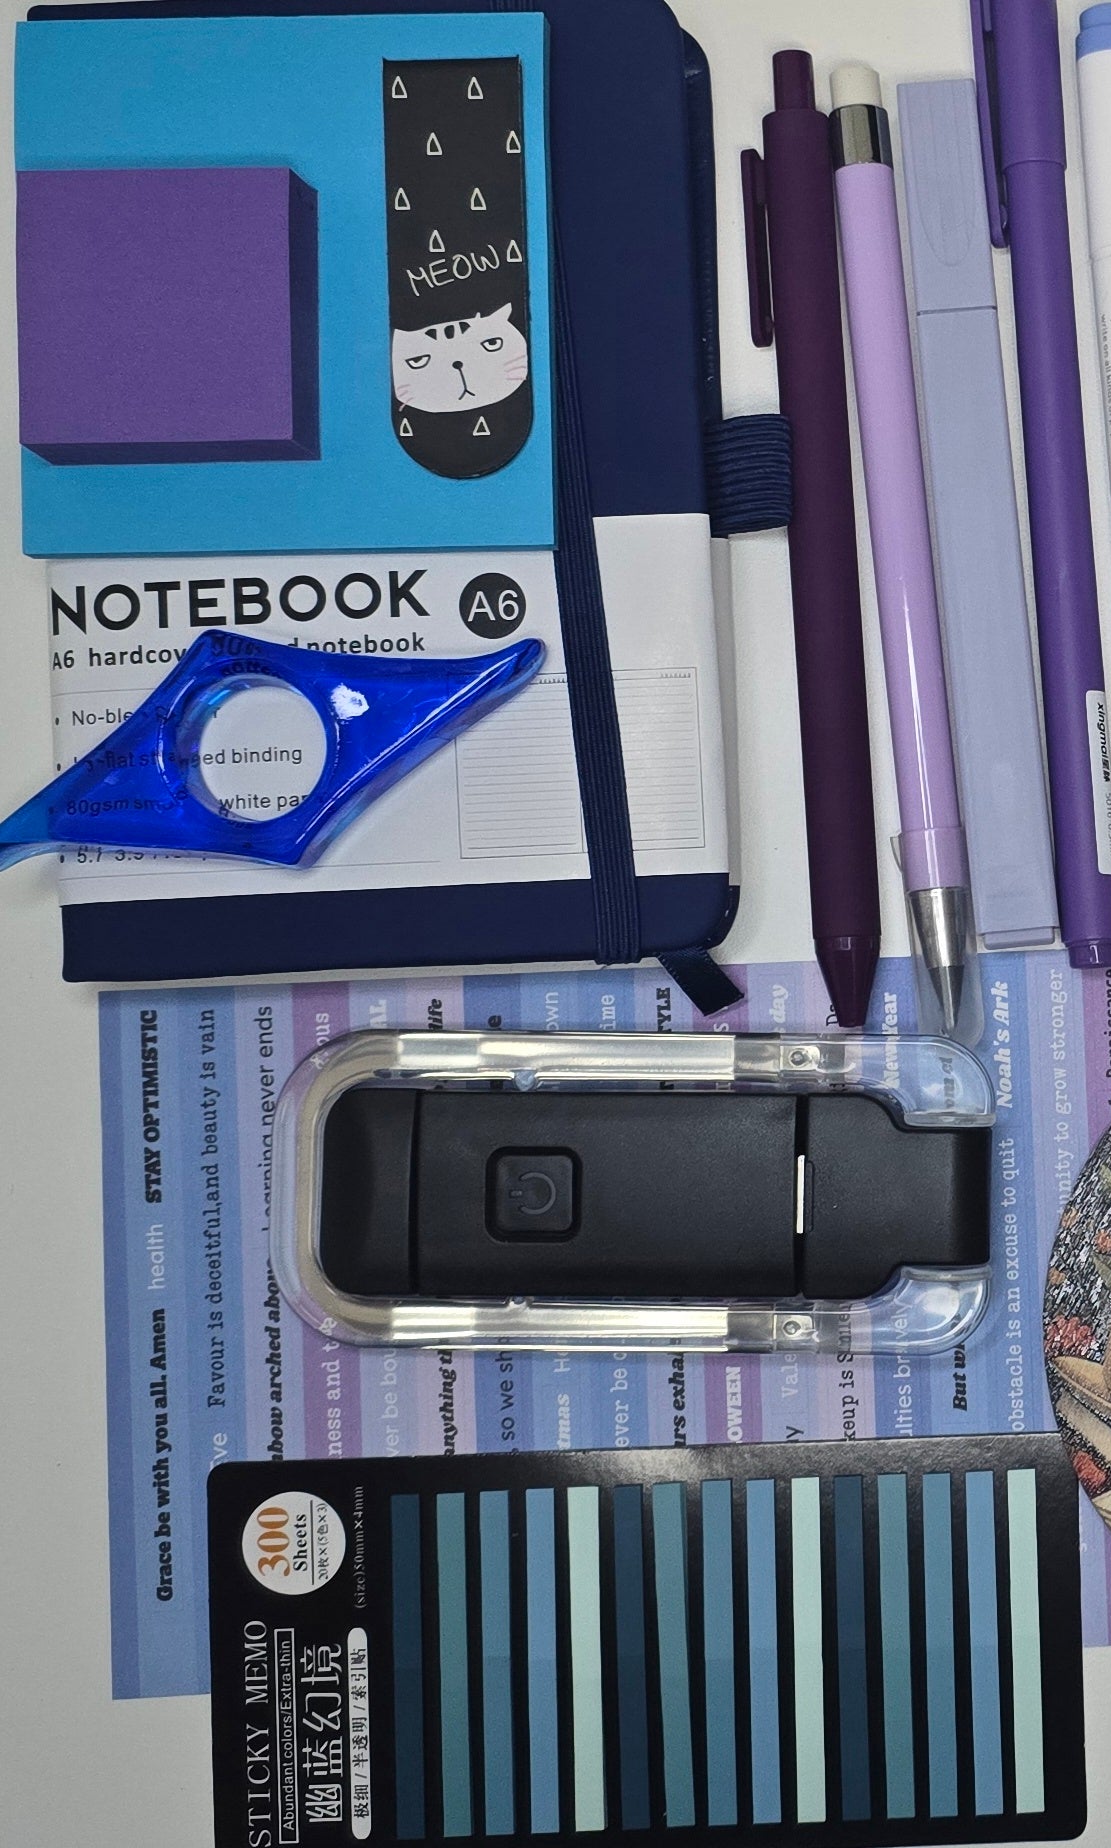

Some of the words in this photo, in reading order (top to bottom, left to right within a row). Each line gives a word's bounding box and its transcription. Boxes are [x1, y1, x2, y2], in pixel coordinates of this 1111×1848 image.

[406, 244, 500, 296] MEOW
[51, 569, 430, 636] NOTEBOOK
[467, 589, 519, 622] A6
[52, 650, 75, 670] A6
[89, 645, 186, 667] hardcov
[307, 632, 426, 654] notebook
[72, 707, 133, 727] No-ble
[232, 746, 303, 766] binding
[219, 793, 272, 811] white
[768, 983, 789, 1023] day
[881, 992, 899, 1035] Year
[990, 981, 1010, 1026] Ark
[1048, 969, 1071, 1061] stronger
[198, 1009, 216, 1055] vain
[254, 1005, 274, 1058] ends
[140, 1010, 161, 1143] OPTIMISTIC
[199, 1062, 216, 1079] is
[993, 1029, 1013, 1108] Noah's
[1053, 1067, 1073, 1115] grow
[258, 1064, 276, 1127] never
[200, 1087, 221, 1154] beauty
[1053, 1122, 1069, 1141] to
[142, 1147, 162, 1204] STAY
[998, 1137, 1019, 1180] quit
[1001, 1186, 1017, 1207] to
[145, 1224, 166, 1290] health
[1003, 1213, 1019, 1280] excuse
[206, 1310, 223, 1330] is
[1007, 1287, 1021, 1312] an
[149, 1309, 167, 1371] Amen
[1004, 1320, 1021, 1339] is
[207, 1336, 226, 1408] Favour
[264, 1326, 282, 1403] arched
[321, 1360, 341, 1400] and
[609, 1368, 628, 1393] be
[838, 1370, 855, 1389] is
[1006, 1344, 1025, 1432] obstacle
[150, 1375, 168, 1409] all.
[382, 1392, 399, 1418] be
[438, 1367, 458, 1458] anything
[500, 1380, 514, 1411] we
[725, 1366, 743, 1443] OWEEN
[952, 1372, 967, 1411] But
[153, 1414, 173, 1454] you
[326, 1407, 343, 1459] ness
[501, 1417, 516, 1441] so
[614, 1400, 631, 1448] ever
[841, 1395, 859, 1441] keup
[151, 1458, 171, 1507] with
[154, 1512, 172, 1538] be
[256, 1507, 291, 1577] 300
[292, 1514, 308, 1571] Sheets
[155, 1541, 174, 1602] Grace
[243, 1620, 269, 1705] MEMO
[279, 1640, 293, 1759] colors/Extra-thin
[299, 1643, 343, 1823] 幽蓝幻境
[245, 1723, 272, 1848] STICKY
[281, 1762, 296, 1831] Abundant
